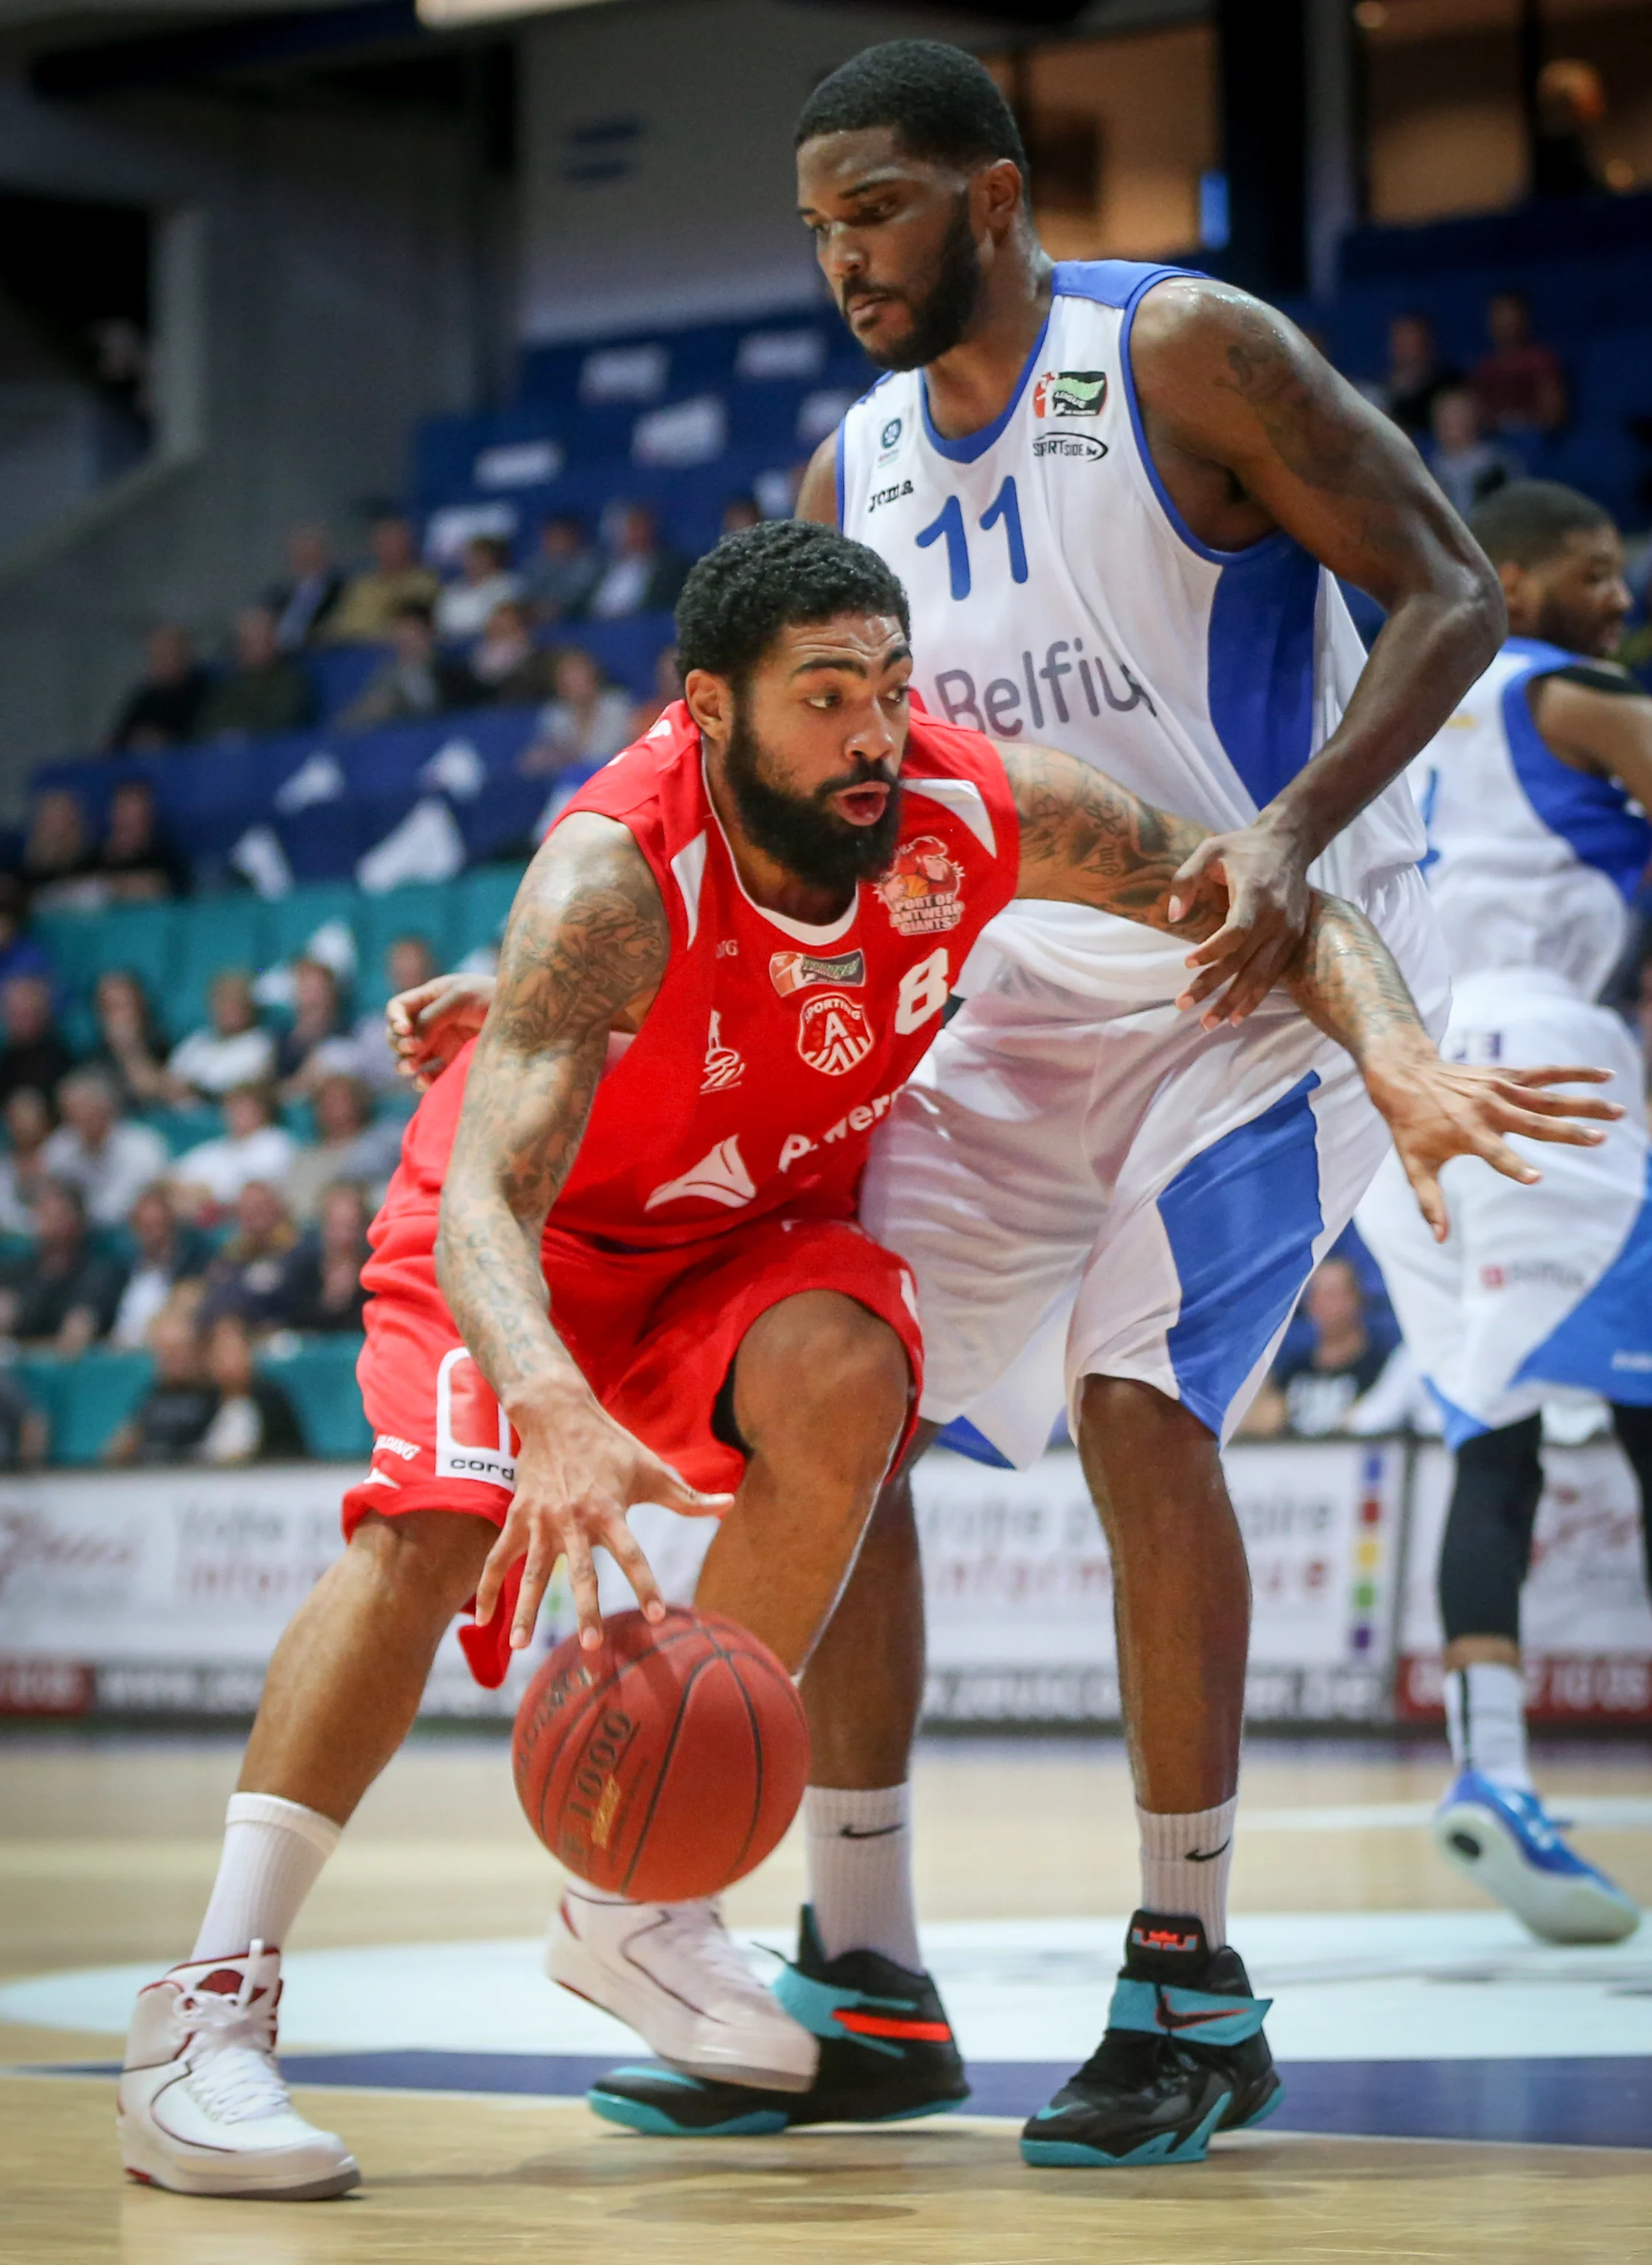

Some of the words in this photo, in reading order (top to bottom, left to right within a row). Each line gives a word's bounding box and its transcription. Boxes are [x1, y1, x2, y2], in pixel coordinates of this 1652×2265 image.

[915, 475, 1029, 601] 11
[934, 638, 1156, 737] Belfiu
[891, 903, 962, 924] ANTWERP
[895, 896, 933, 912] PORT
[934, 893, 953, 906] OF
[900, 916, 952, 933] GIANTS
[895, 948, 951, 1036] 8
[805, 998, 861, 1024] SPORTING
[450, 1459, 516, 1481] cord
